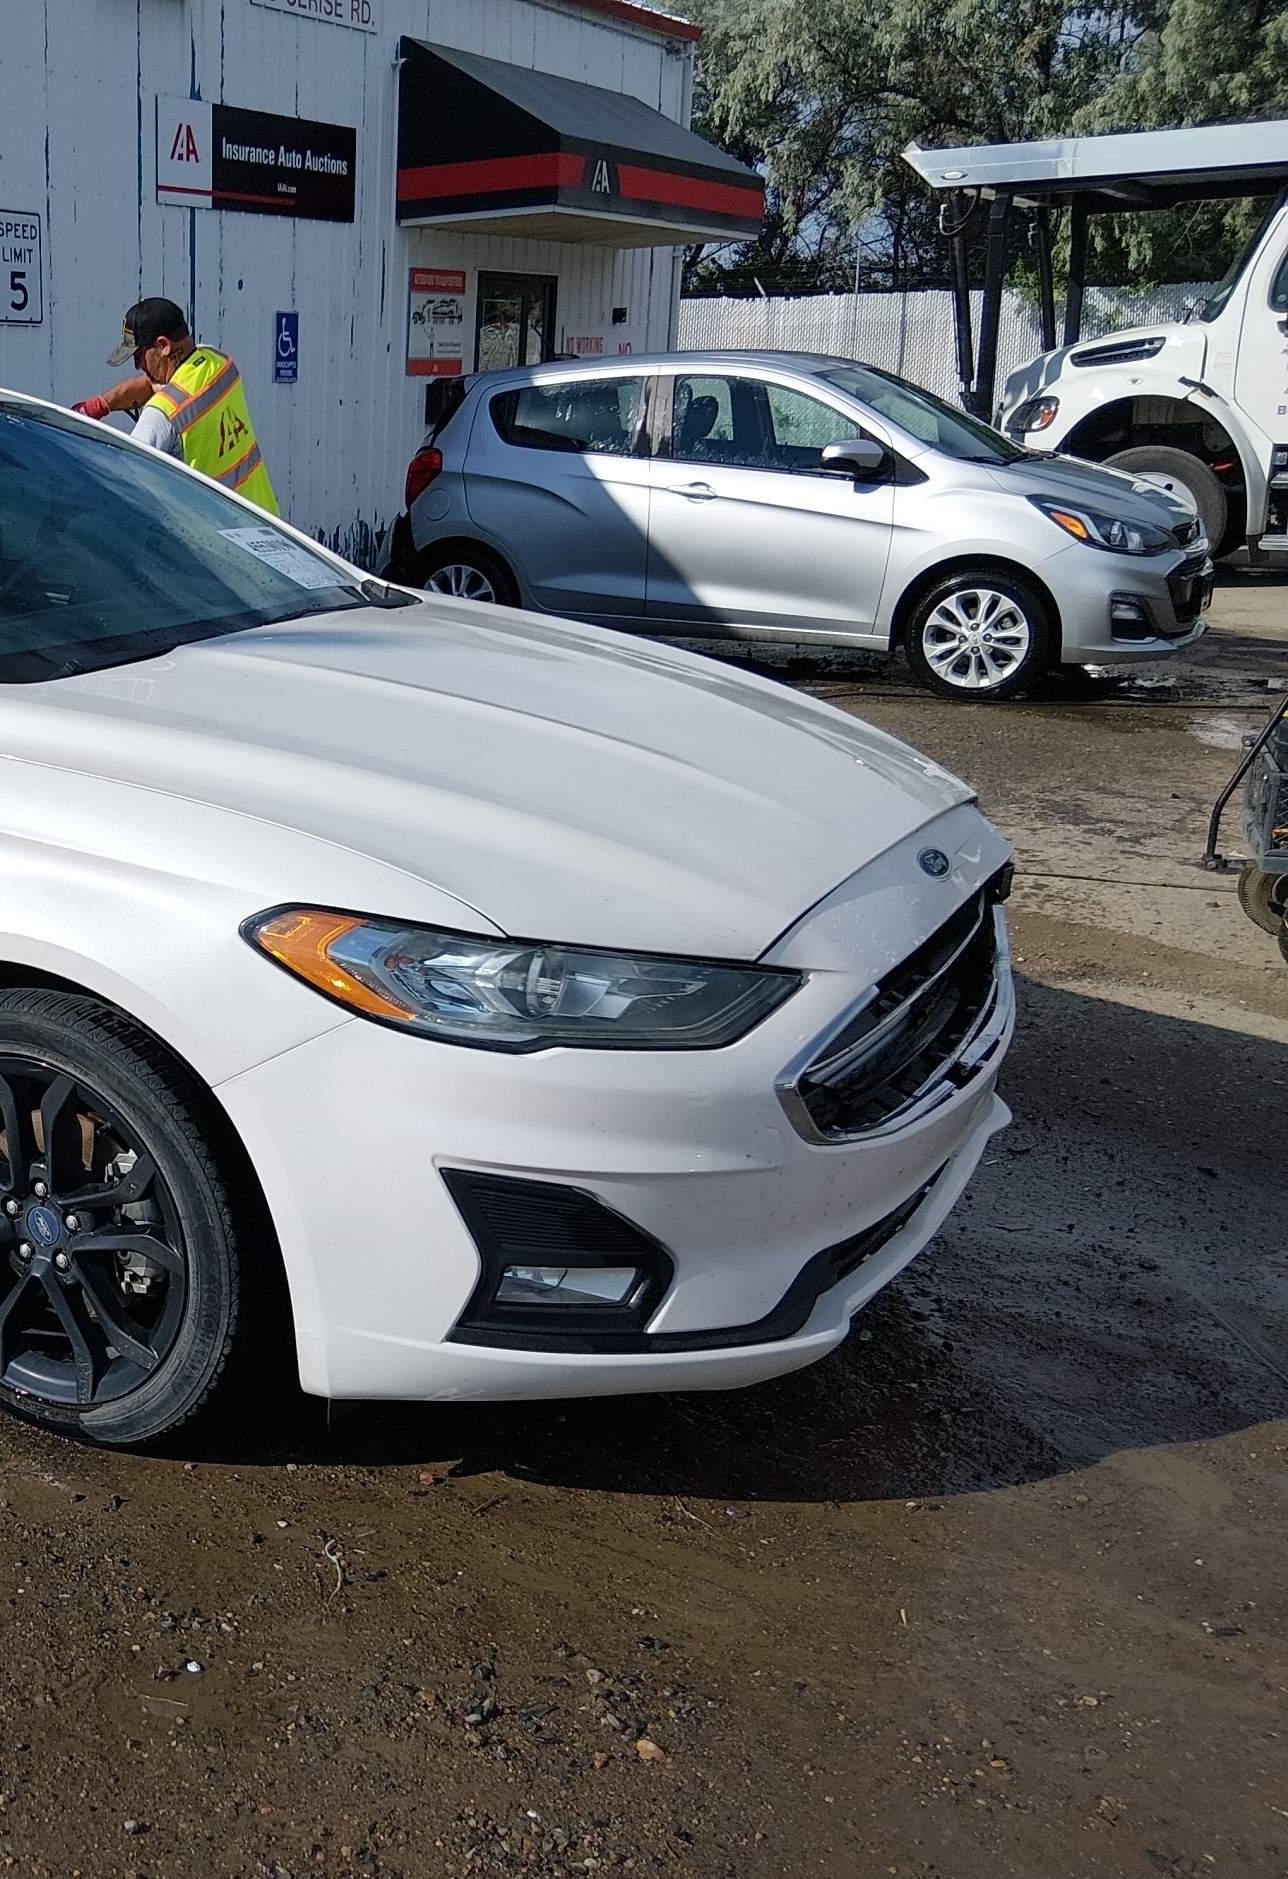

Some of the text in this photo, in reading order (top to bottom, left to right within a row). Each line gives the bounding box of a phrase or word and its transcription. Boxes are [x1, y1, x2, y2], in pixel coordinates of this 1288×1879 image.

[286, 0, 375, 26] RISE RD.
[222, 137, 348, 176] Insurance Auto Auctions
[2, 246, 33, 264] LIMIT
[10, 271, 28, 311] 5
